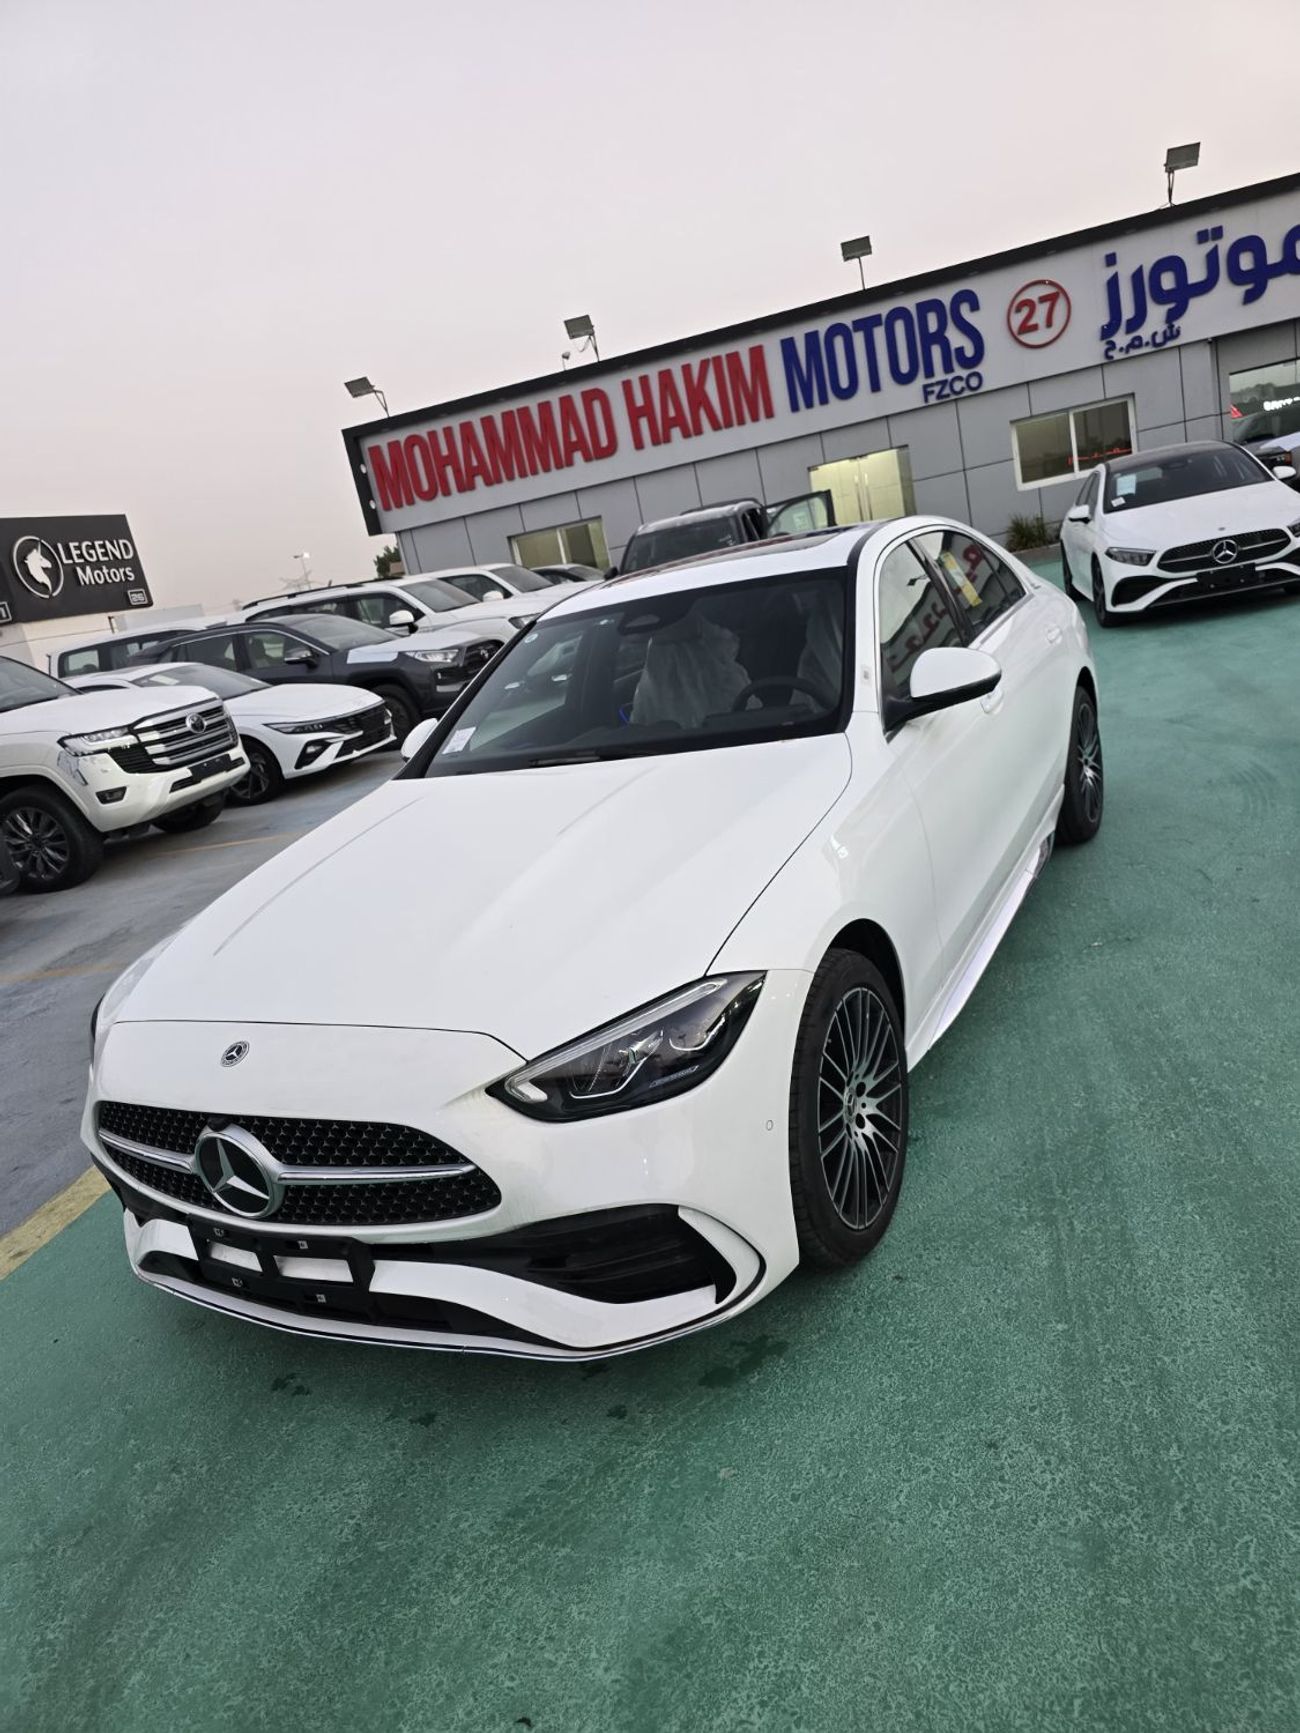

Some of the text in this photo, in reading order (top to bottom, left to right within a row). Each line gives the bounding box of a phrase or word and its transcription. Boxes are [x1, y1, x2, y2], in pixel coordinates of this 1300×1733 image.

[1014, 290, 1061, 336] 27
[368, 288, 985, 512] MOHAMMAD HAKIM MOTORS
[922, 370, 984, 404] FZCO
[57, 538, 135, 564] LEGEND
[76, 565, 136, 586] Motors
